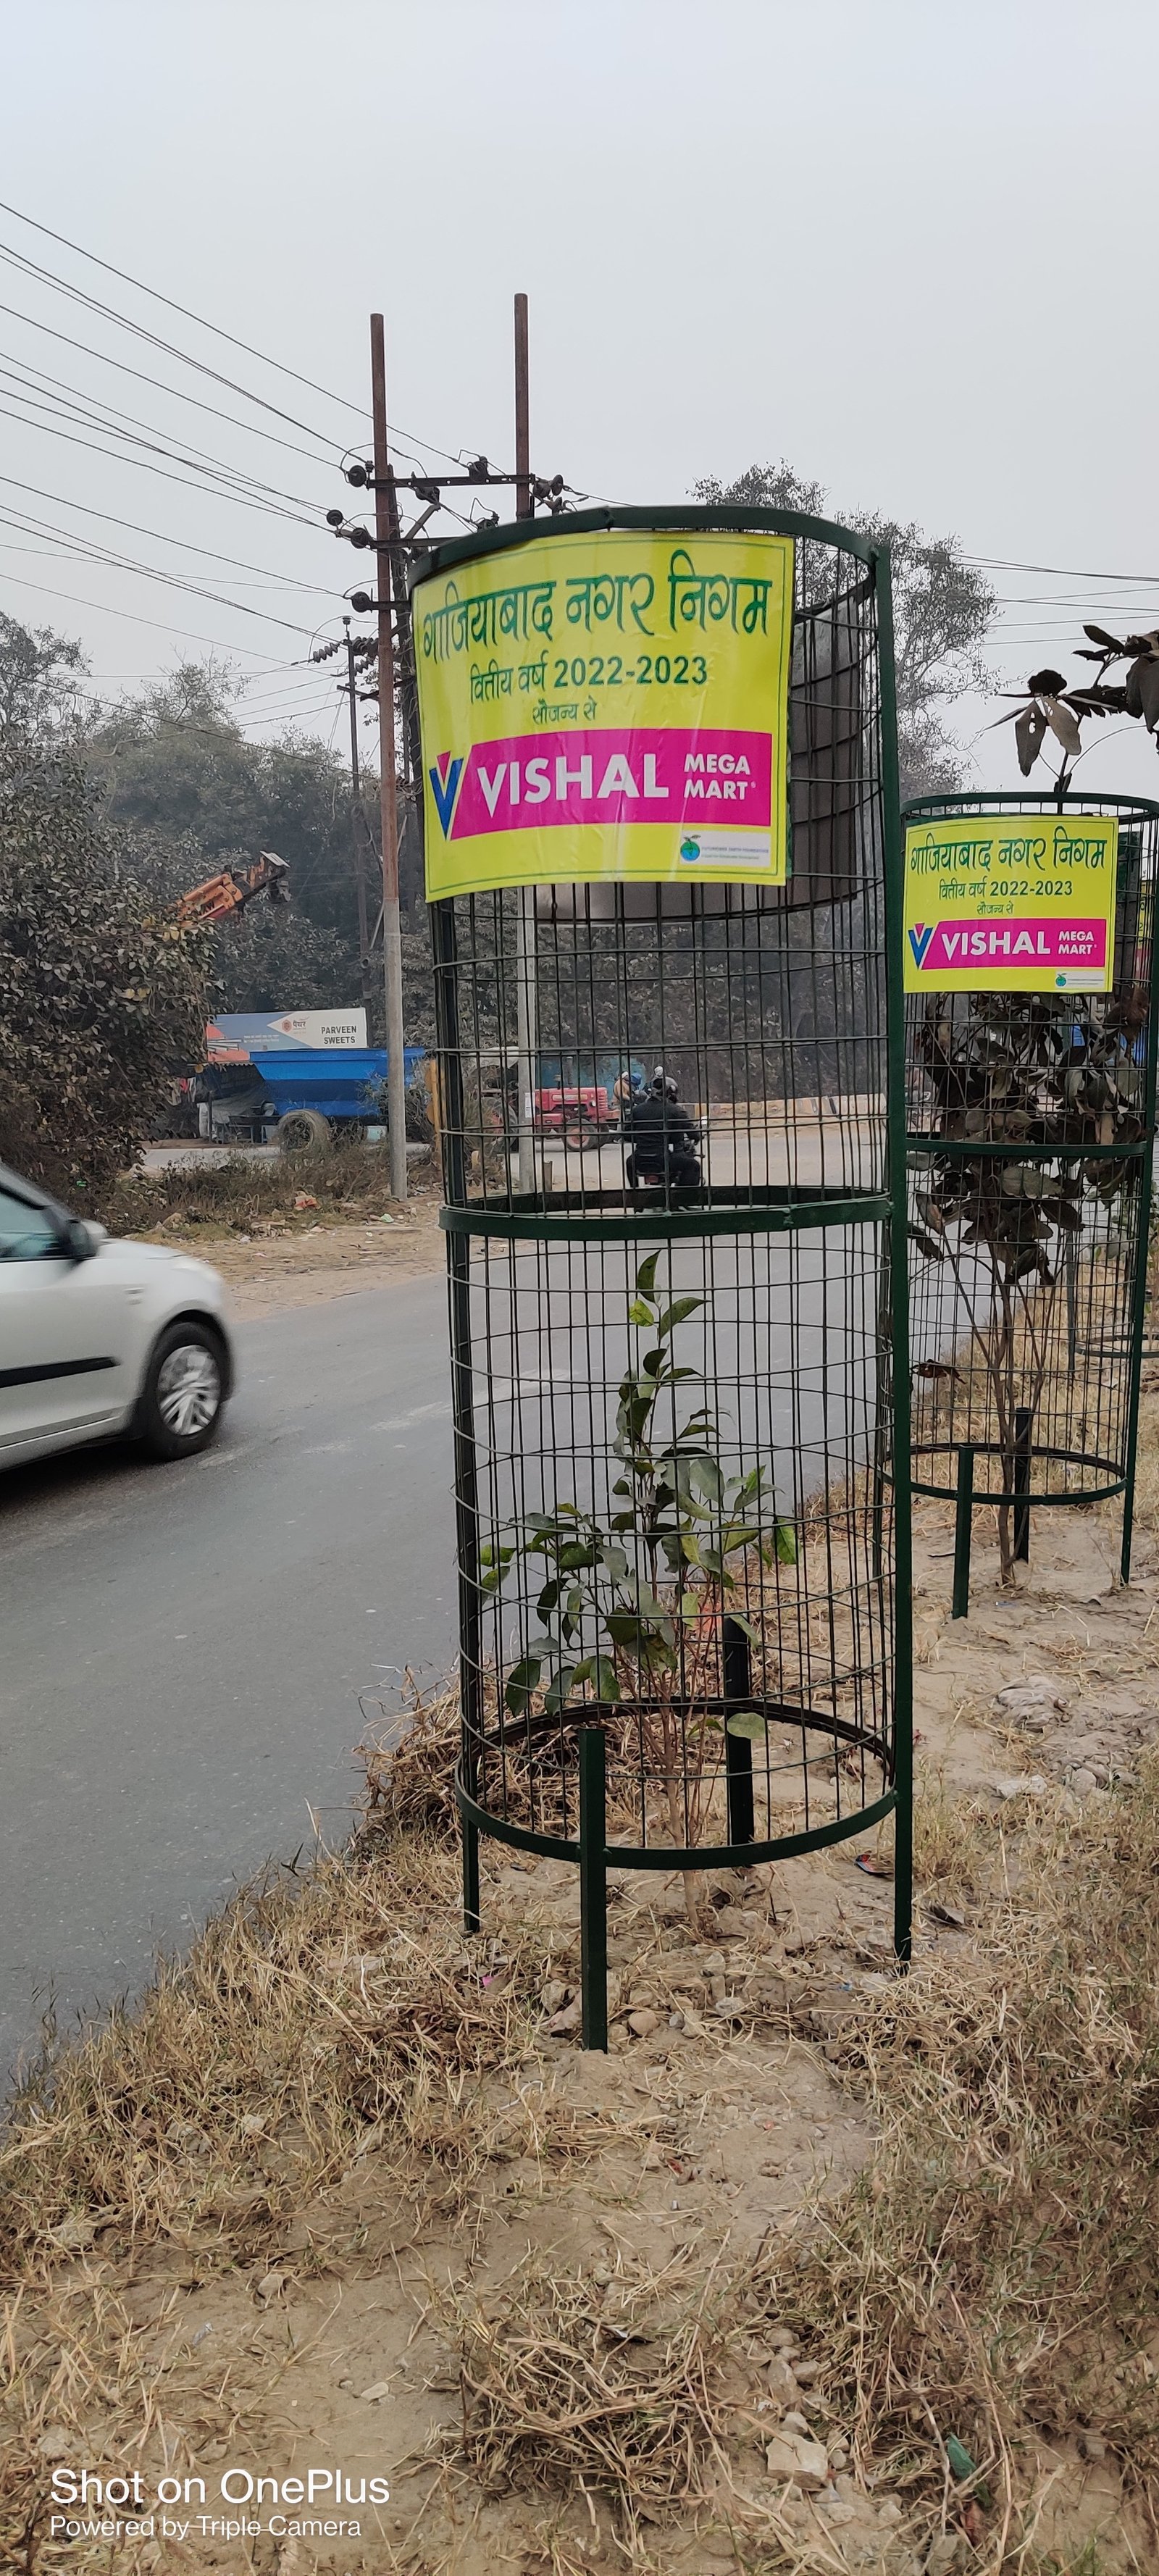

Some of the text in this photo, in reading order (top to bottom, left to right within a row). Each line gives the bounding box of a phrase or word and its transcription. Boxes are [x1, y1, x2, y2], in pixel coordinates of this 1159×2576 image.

[424, 549, 773, 664] गाजियाबाद नगर निगम
[469, 650, 708, 704] वित्तीय वर्ष 2022-2023
[532, 695, 598, 724] सौजन्य से
[477, 753, 669, 819] VISHAL
[684, 754, 750, 776] MEGA
[684, 779, 749, 800] MART
[911, 826, 1108, 876] गाजियाबाद नगर निगम
[968, 875, 987, 898] वर्ष
[989, 880, 1073, 896] 2022-2023
[941, 931, 1051, 961] VISHAL
[1058, 931, 1095, 942] MEGA
[1058, 943, 1093, 955] MART
[321, 1025, 357, 1034] PARVEEN
